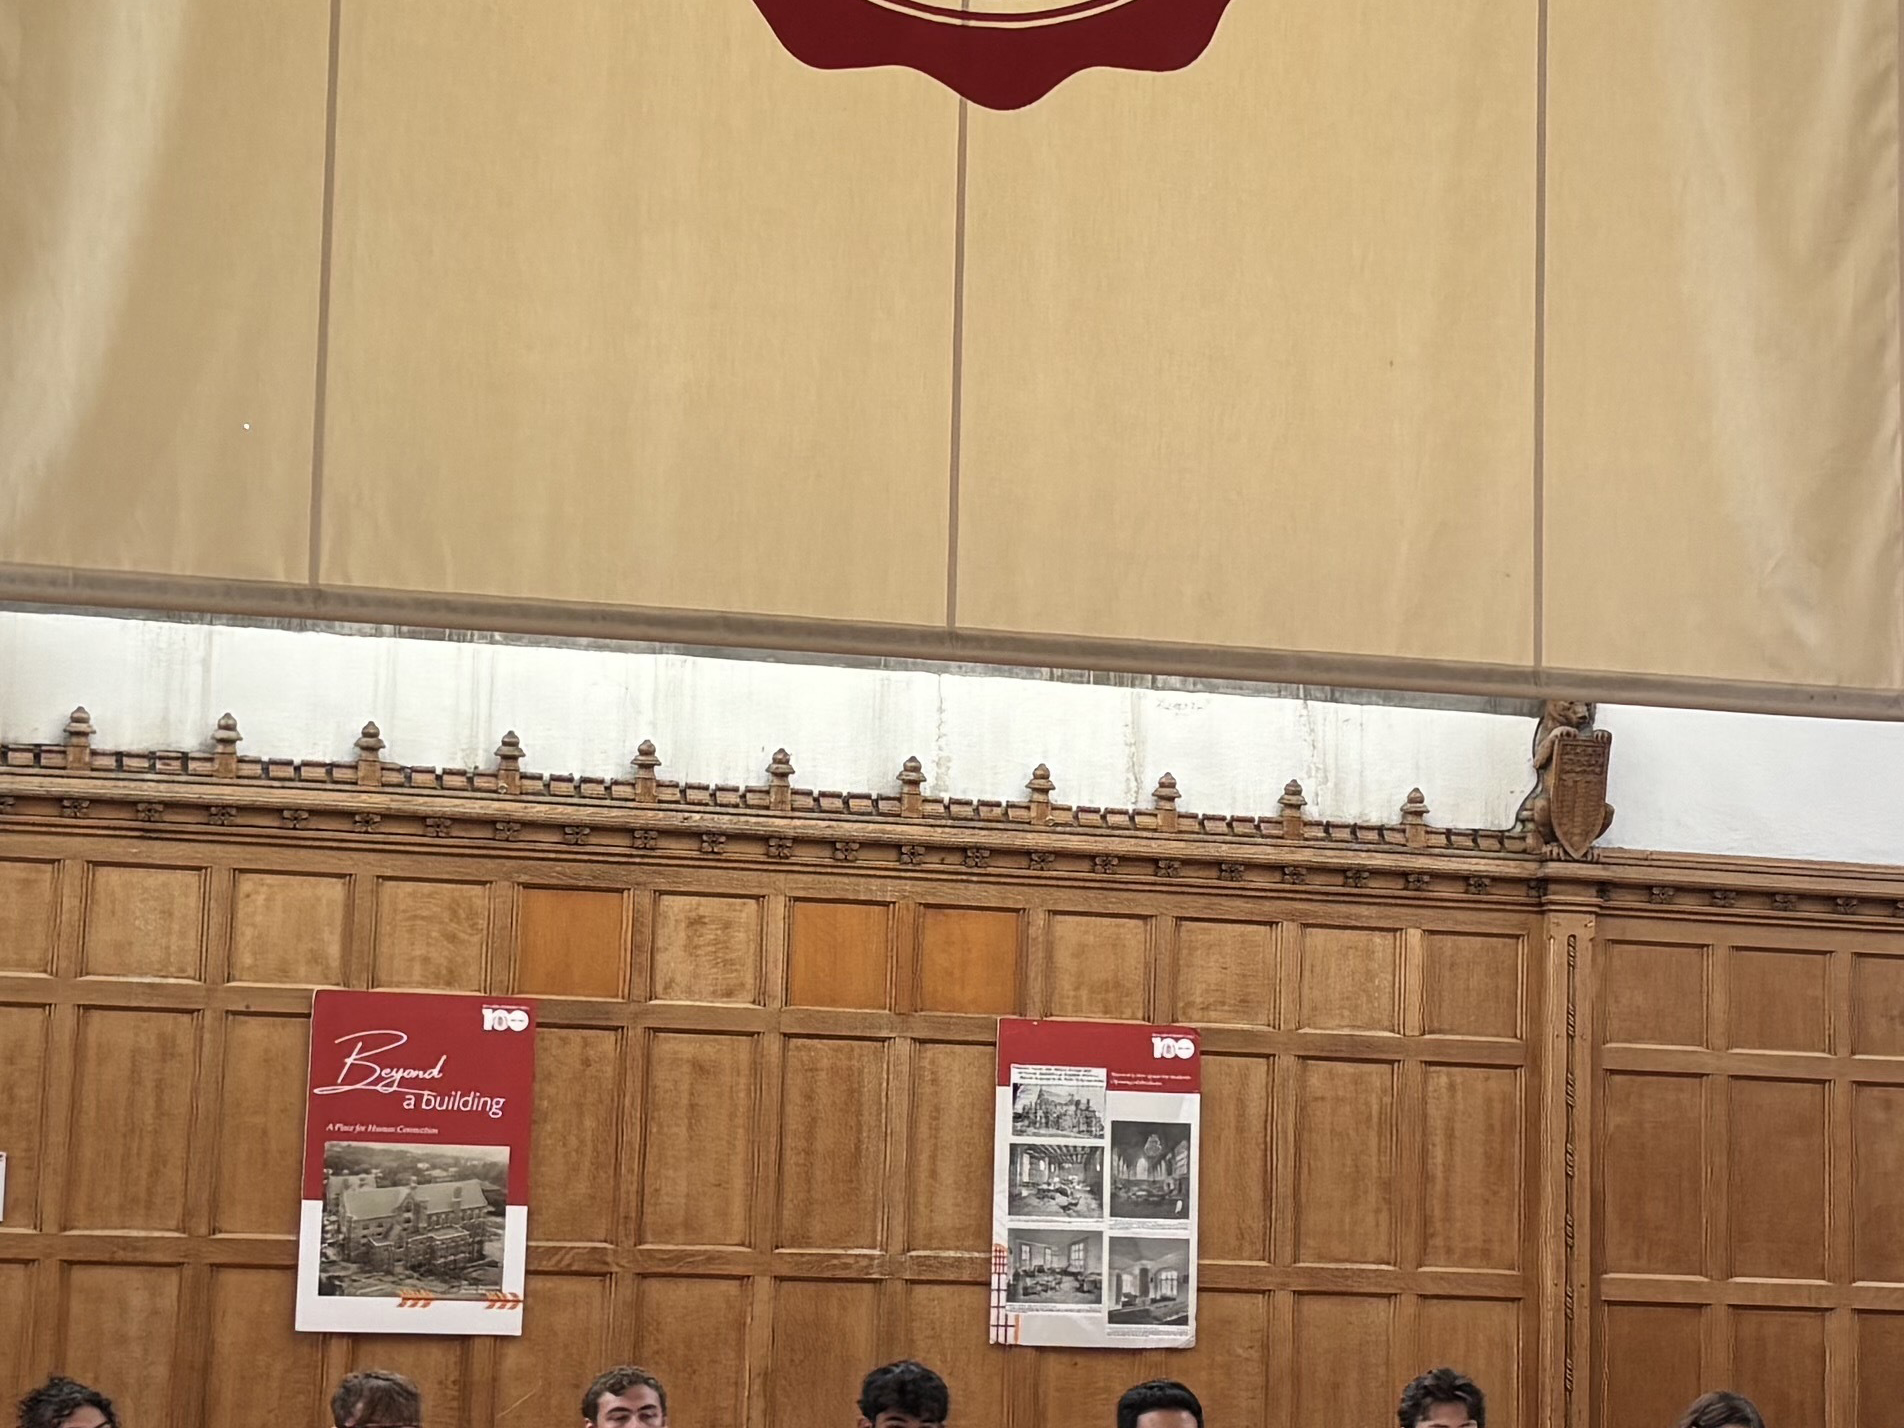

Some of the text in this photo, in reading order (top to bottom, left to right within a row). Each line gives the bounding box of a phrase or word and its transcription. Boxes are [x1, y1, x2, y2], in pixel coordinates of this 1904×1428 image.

[482, 1008, 529, 1031] 100
[1152, 1037, 1194, 1059] 100
[313, 1030, 447, 1094] Beyond
[403, 1091, 506, 1118] a building
